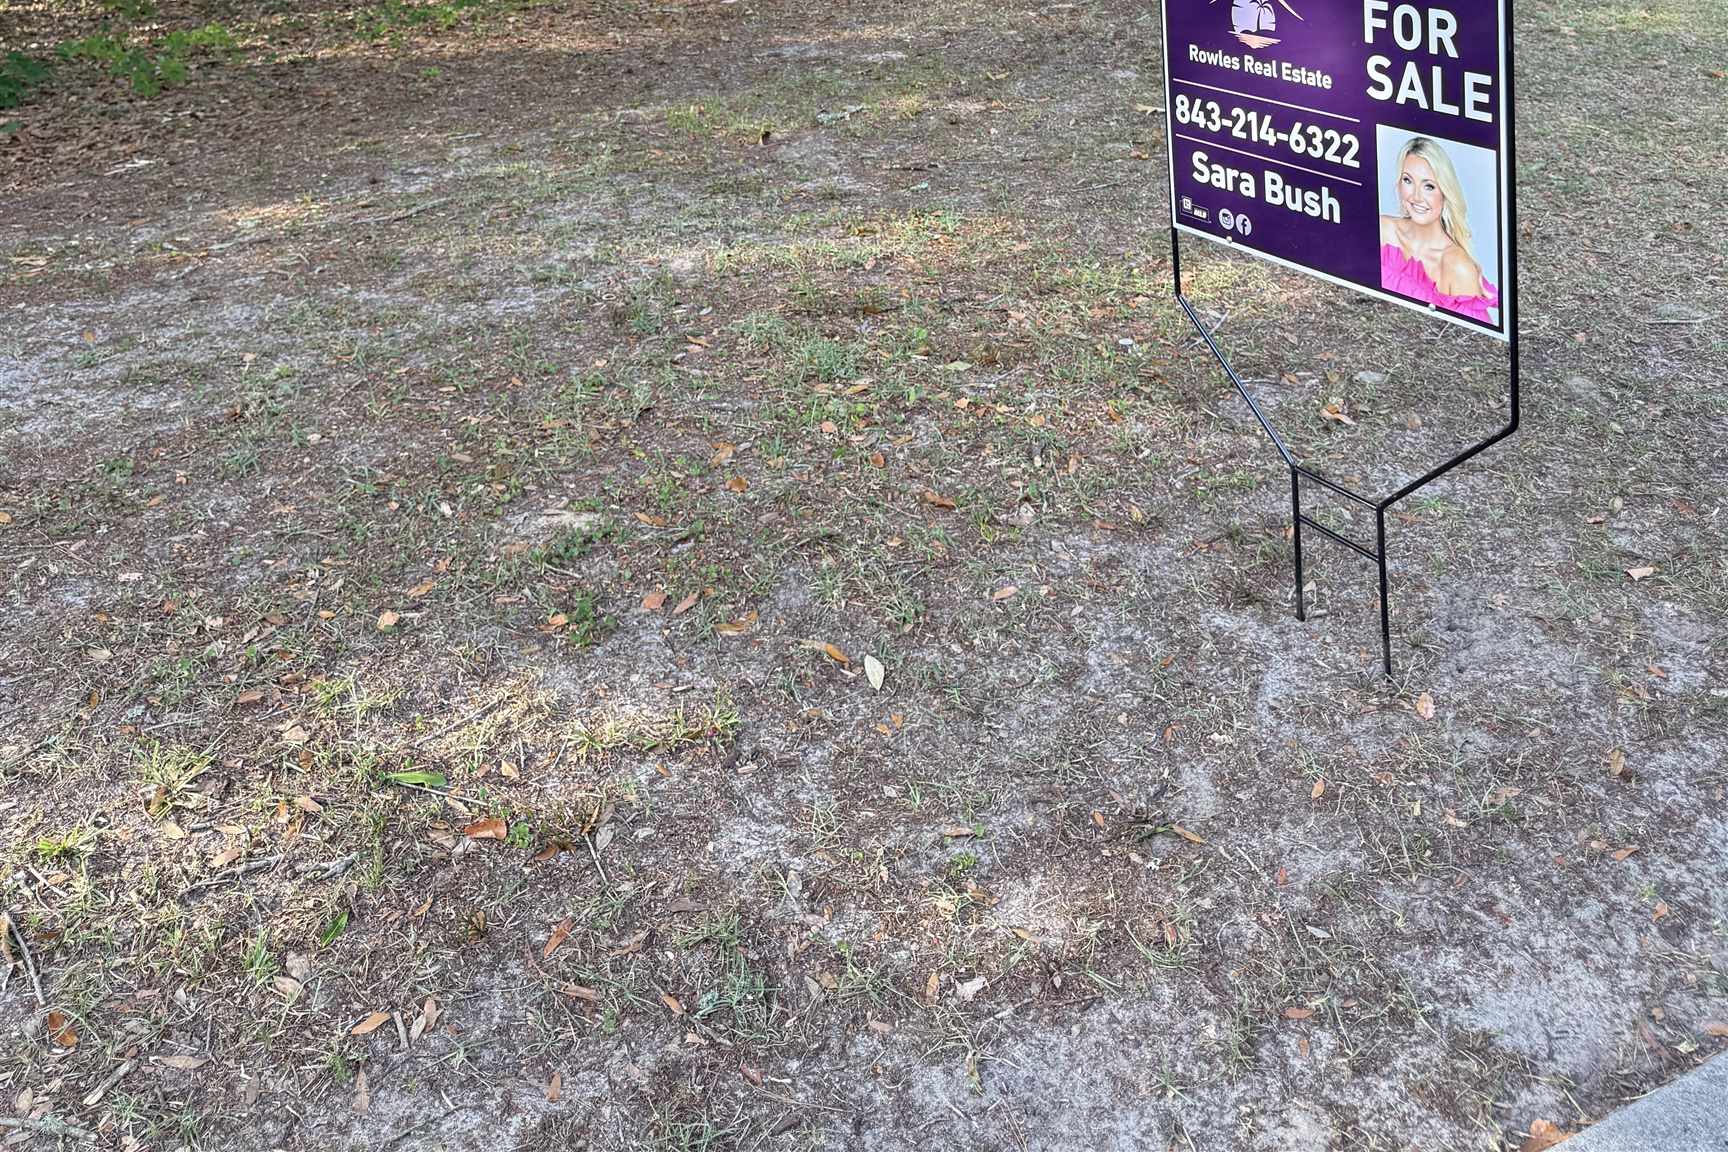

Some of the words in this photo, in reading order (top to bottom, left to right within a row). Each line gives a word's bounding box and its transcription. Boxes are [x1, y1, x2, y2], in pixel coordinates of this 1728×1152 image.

[1364, 0, 1459, 58] FOR
[1189, 44, 1240, 70] Rowles
[1244, 55, 1278, 78] Real
[1281, 62, 1333, 89] Estate
[1366, 55, 1493, 123] SALE
[1175, 94, 1360, 168] 843-214-6322
[1192, 151, 1256, 198] Sara
[1264, 170, 1341, 224] Bush
